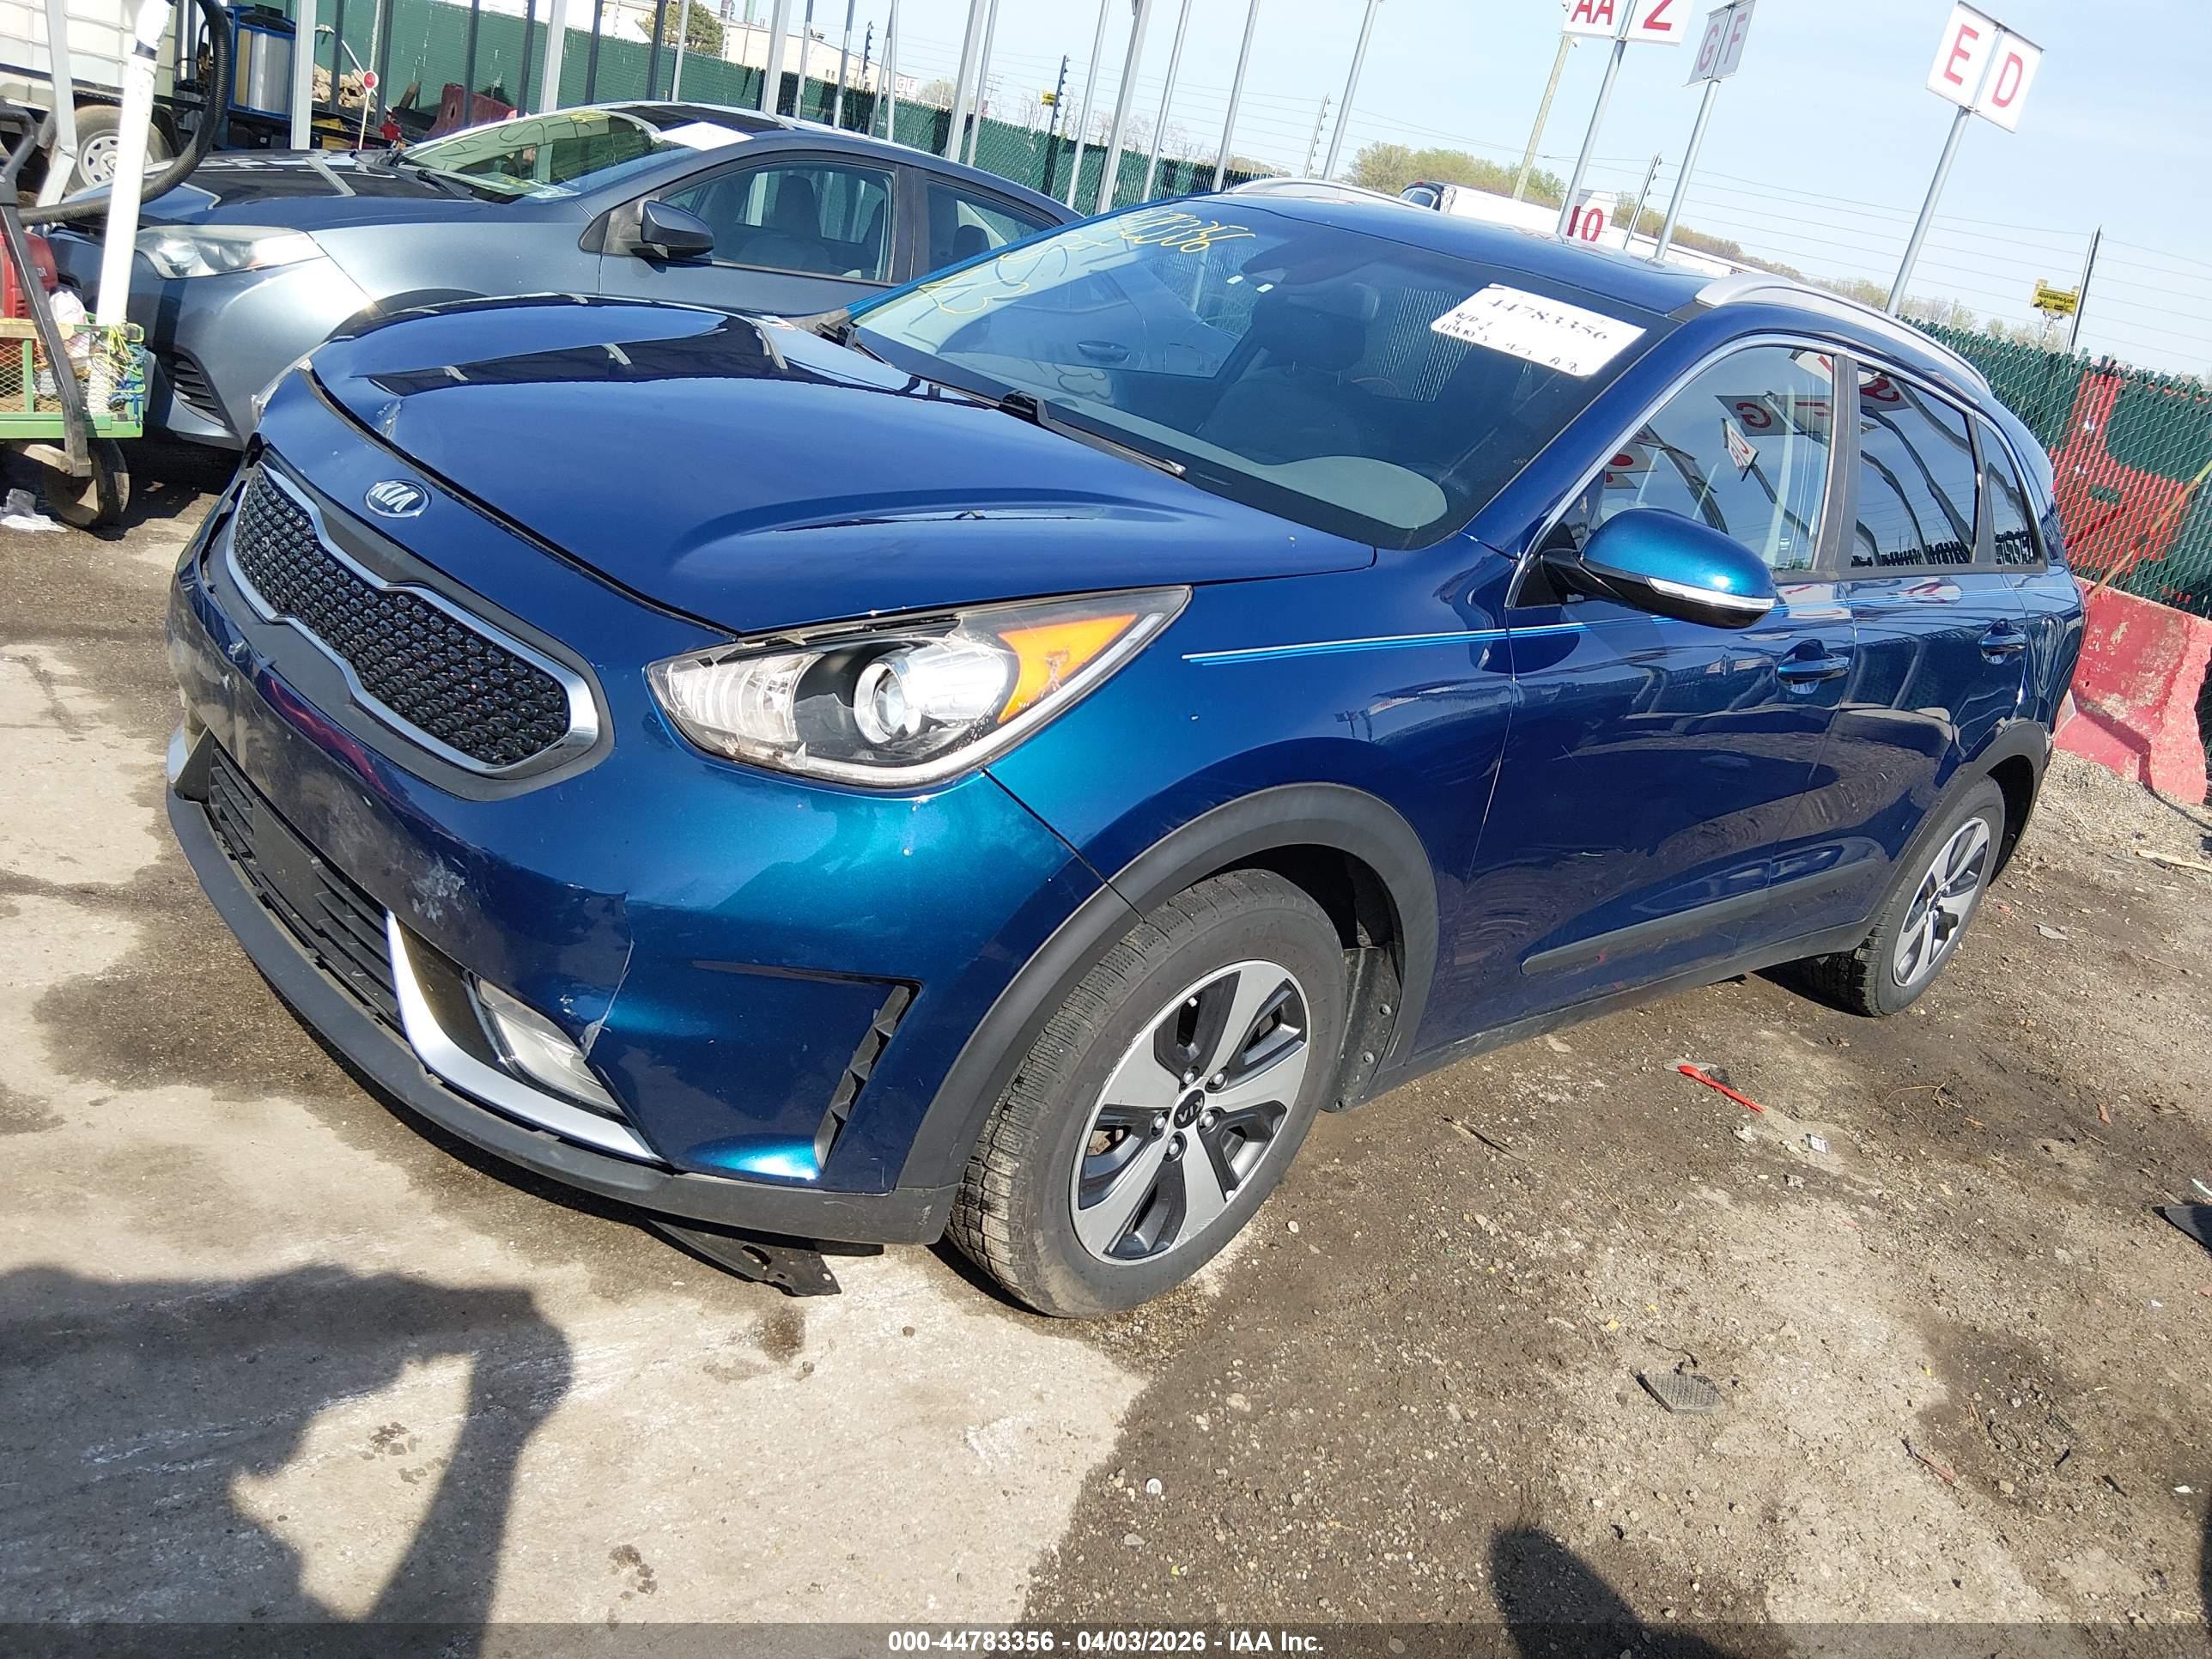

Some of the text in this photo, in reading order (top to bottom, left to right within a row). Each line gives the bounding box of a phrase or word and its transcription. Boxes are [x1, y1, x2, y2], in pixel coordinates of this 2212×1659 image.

[1698, 13, 1747, 72] G F
[1944, 23, 2023, 108] E D
[1566, 205, 1604, 242] 10
[369, 483, 419, 513] KIA
[1177, 1097, 1203, 1123] KIA
